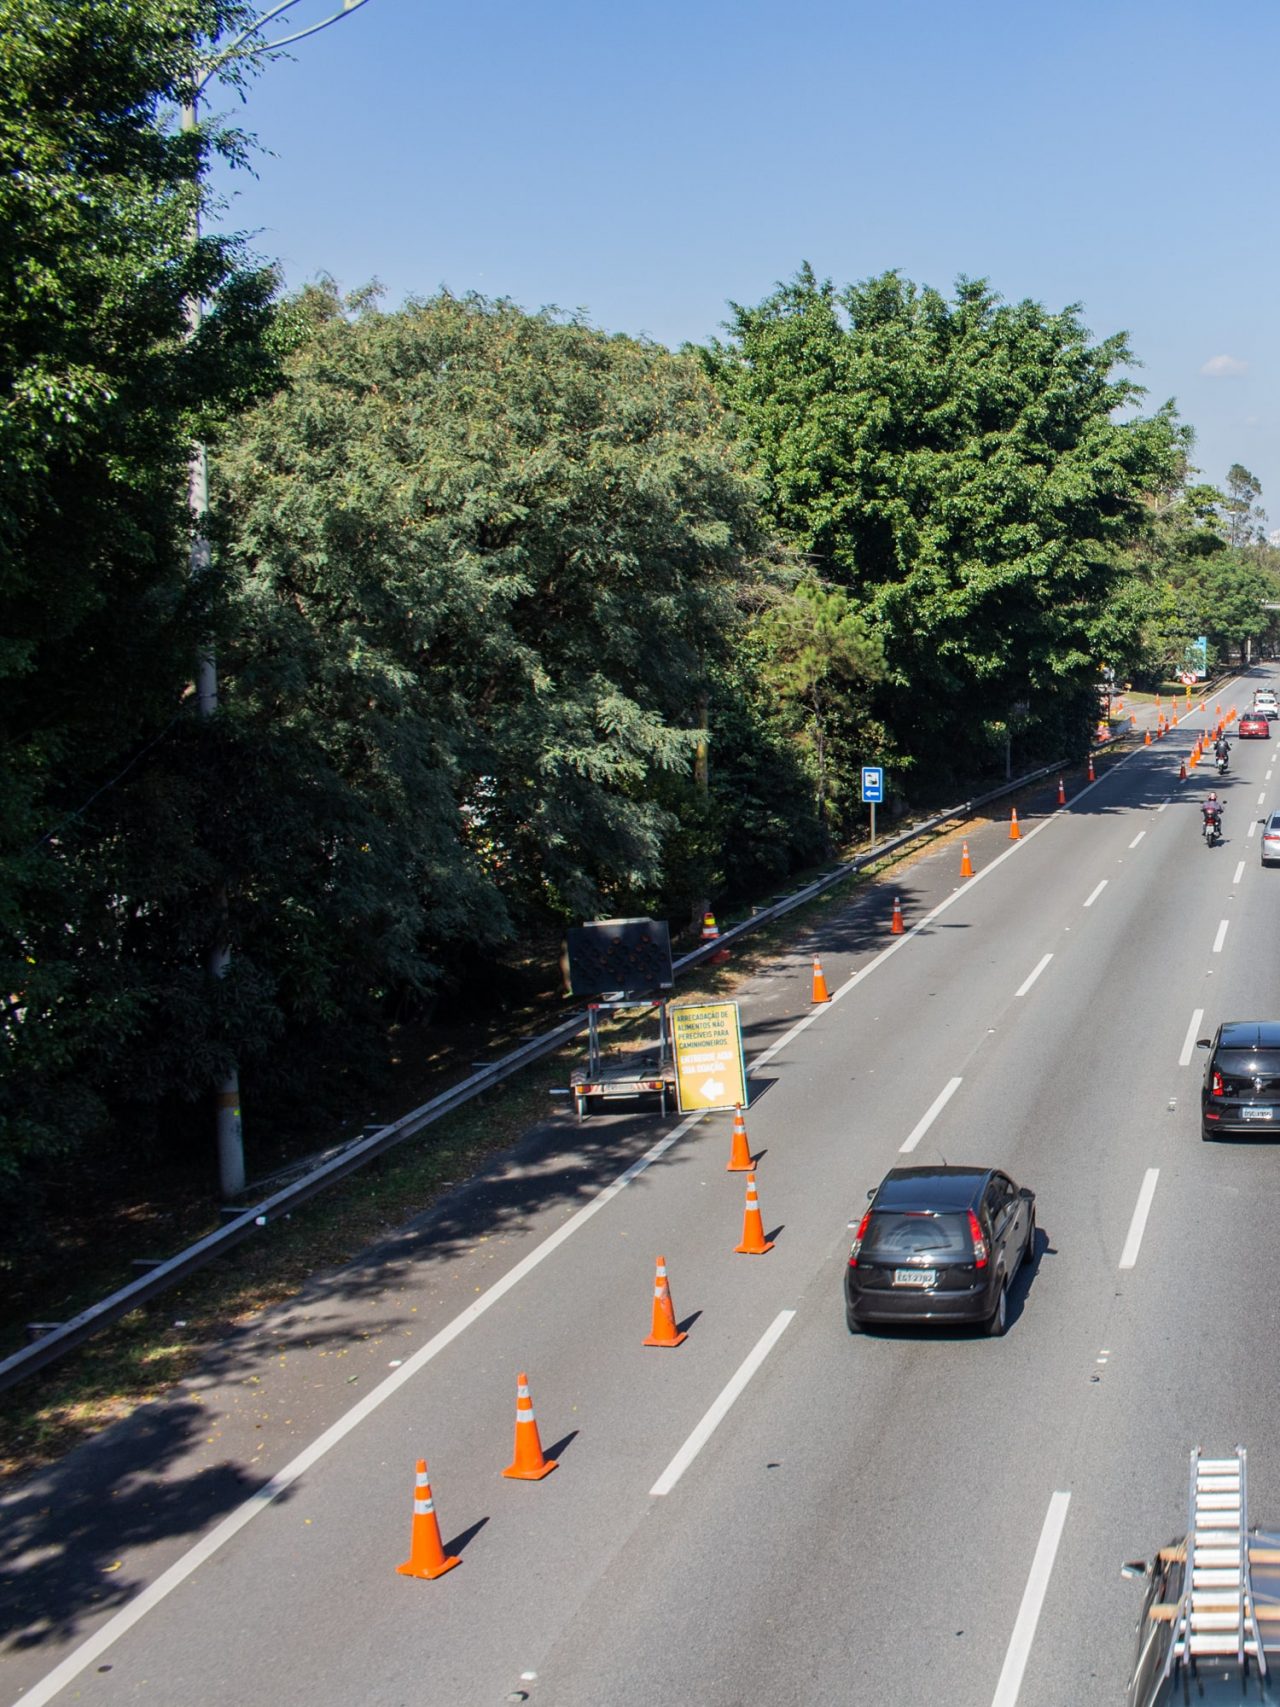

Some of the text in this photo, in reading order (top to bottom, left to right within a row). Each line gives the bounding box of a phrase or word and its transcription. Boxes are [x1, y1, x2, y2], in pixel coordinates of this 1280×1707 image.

[677, 1012, 720, 1022] ARRECADAÇÃO
[678, 1020, 725, 1031] ALIMENTOS NÃO
[678, 1029, 729, 1040] PERECÍVEIS PARA
